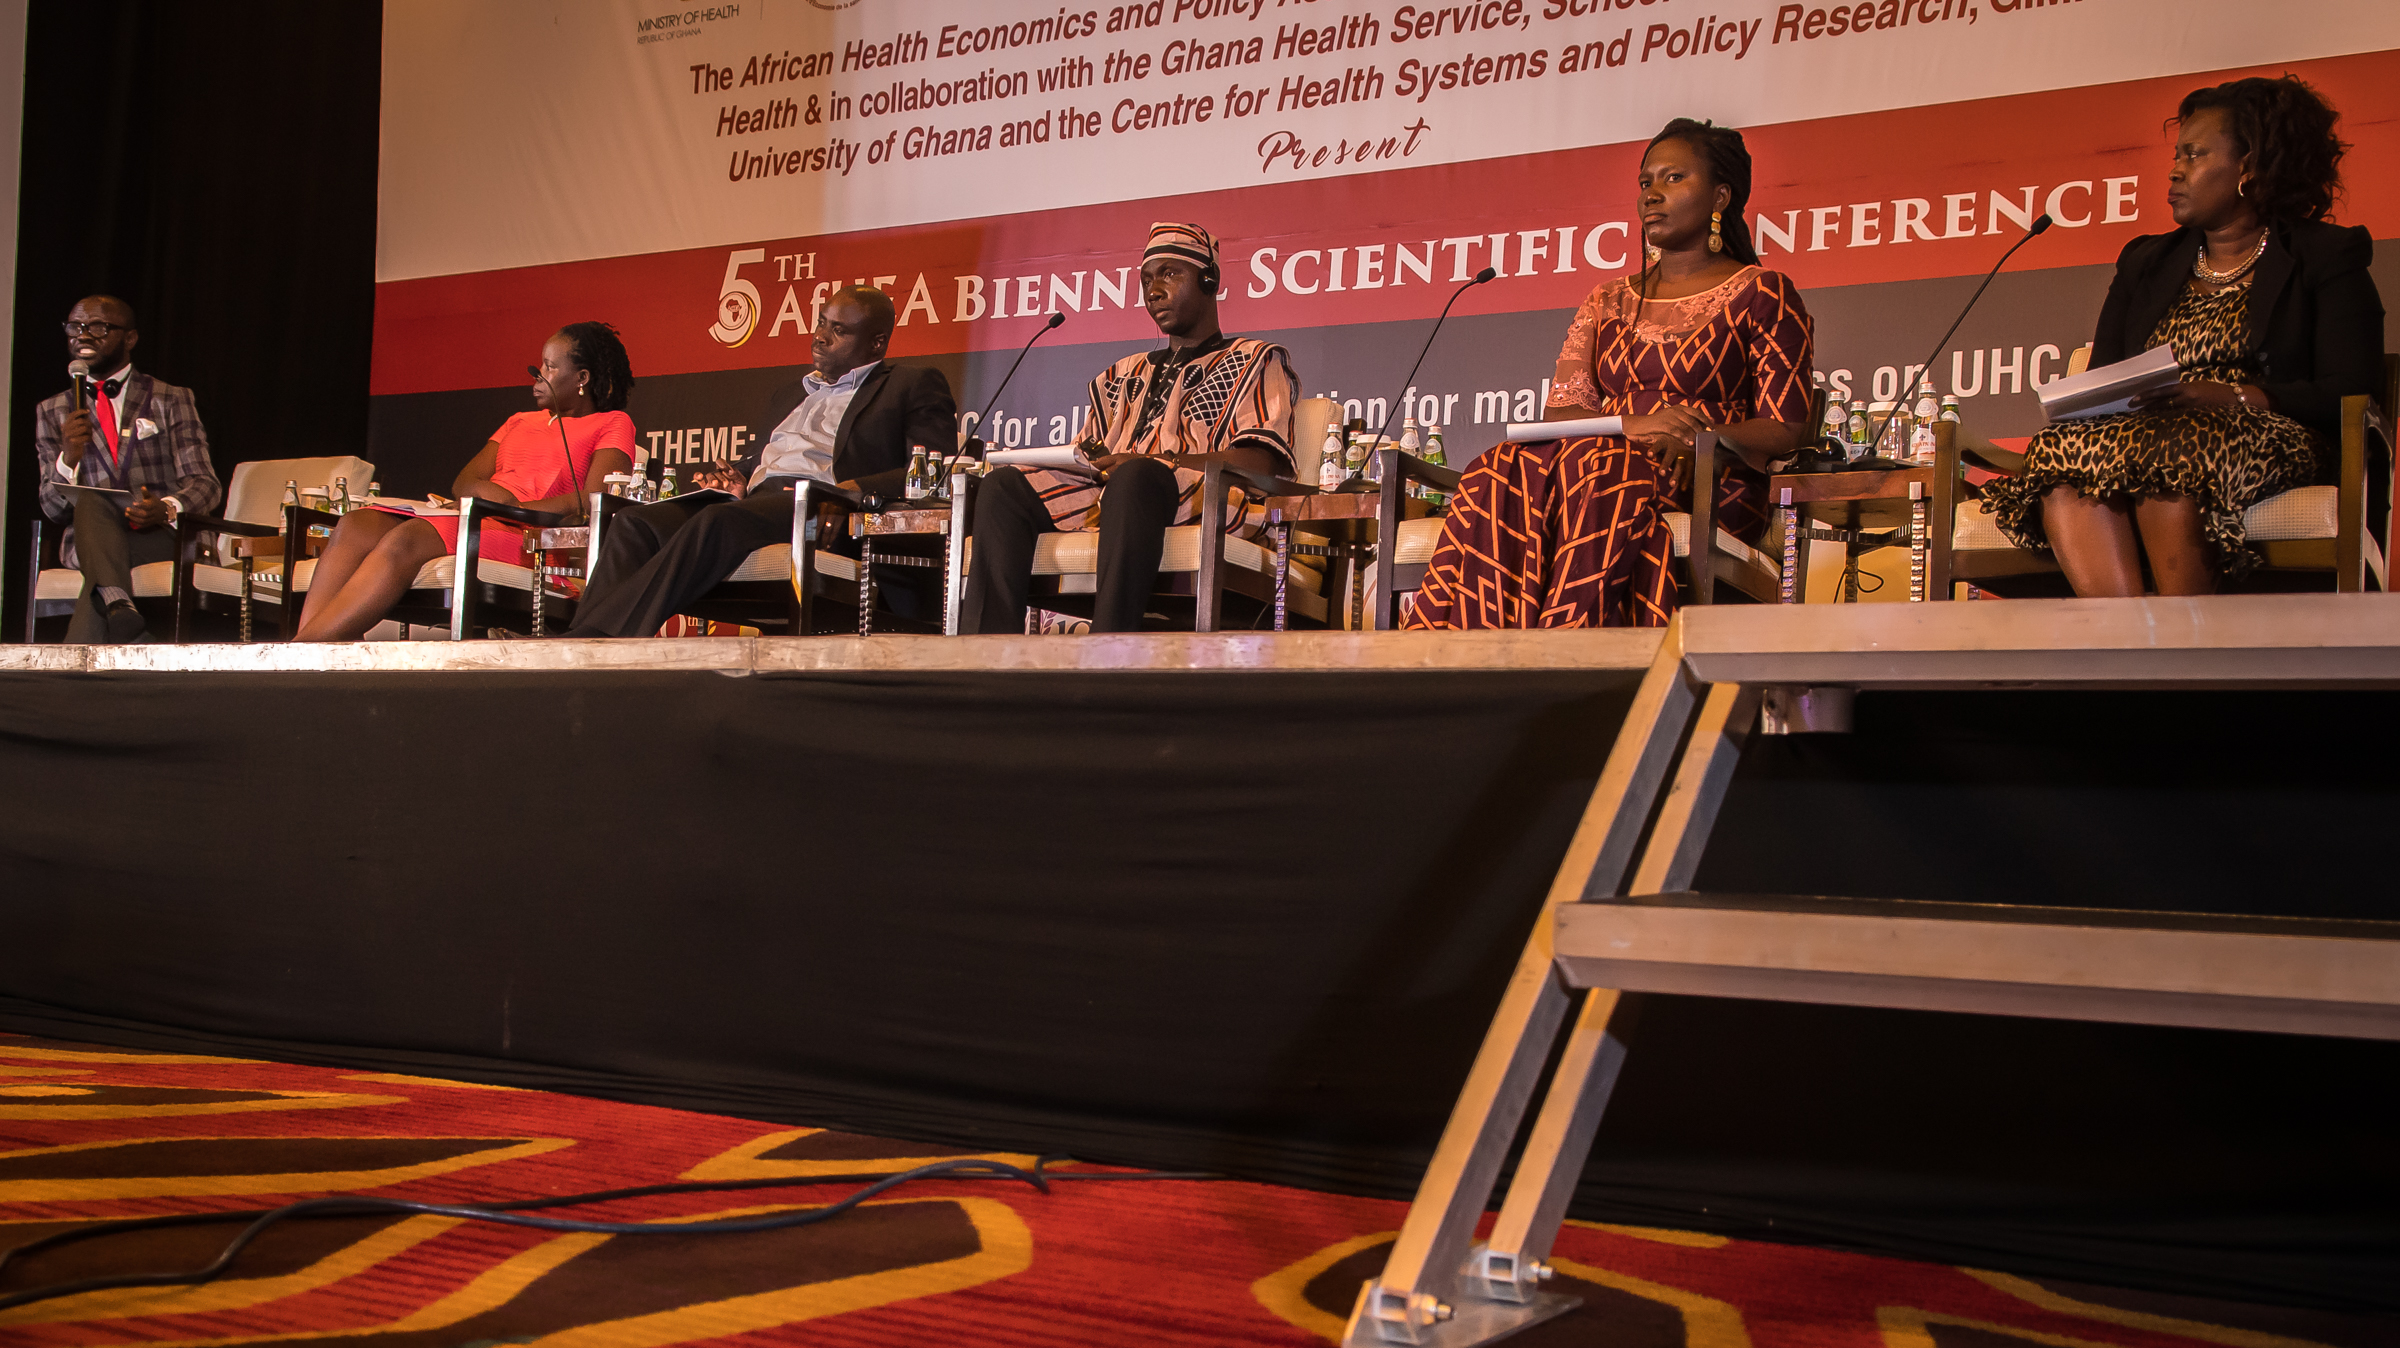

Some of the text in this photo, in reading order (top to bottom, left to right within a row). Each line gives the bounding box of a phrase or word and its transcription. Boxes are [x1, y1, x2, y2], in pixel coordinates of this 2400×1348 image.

[637, 4, 740, 33] MINISTRY OF HEALTH
[676, 27, 702, 39] GHANA
[690, 63, 733, 94] The
[739, 50, 834, 88] African
[841, 30, 928, 73] Health
[936, 6, 1098, 59] Economics
[1105, 0, 1164, 33] and
[715, 97, 798, 137] Health
[804, 94, 822, 125] &
[829, 90, 851, 122] in
[859, 67, 1028, 118] collaboration
[1037, 55, 1094, 93] with
[1103, 48, 1152, 84] the
[1161, 36, 1264, 76] Ghana
[1272, 13, 1381, 61] Health
[1390, 0, 1531, 43] Service,
[729, 0, 1978, 182] University of Ghana and the Centre for Health Systems and Policy Research,
[1257, 116, 1431, 174] Present
[773, 252, 817, 282] TH
[1247, 221, 1629, 300] SCIENTIFIC
[1755, 175, 2139, 256] NFERENCE
[992, 410, 1038, 448] for
[1403, 386, 1459, 427] for
[1872, 363, 1930, 402] on
[1951, 344, 2061, 398] UHC
